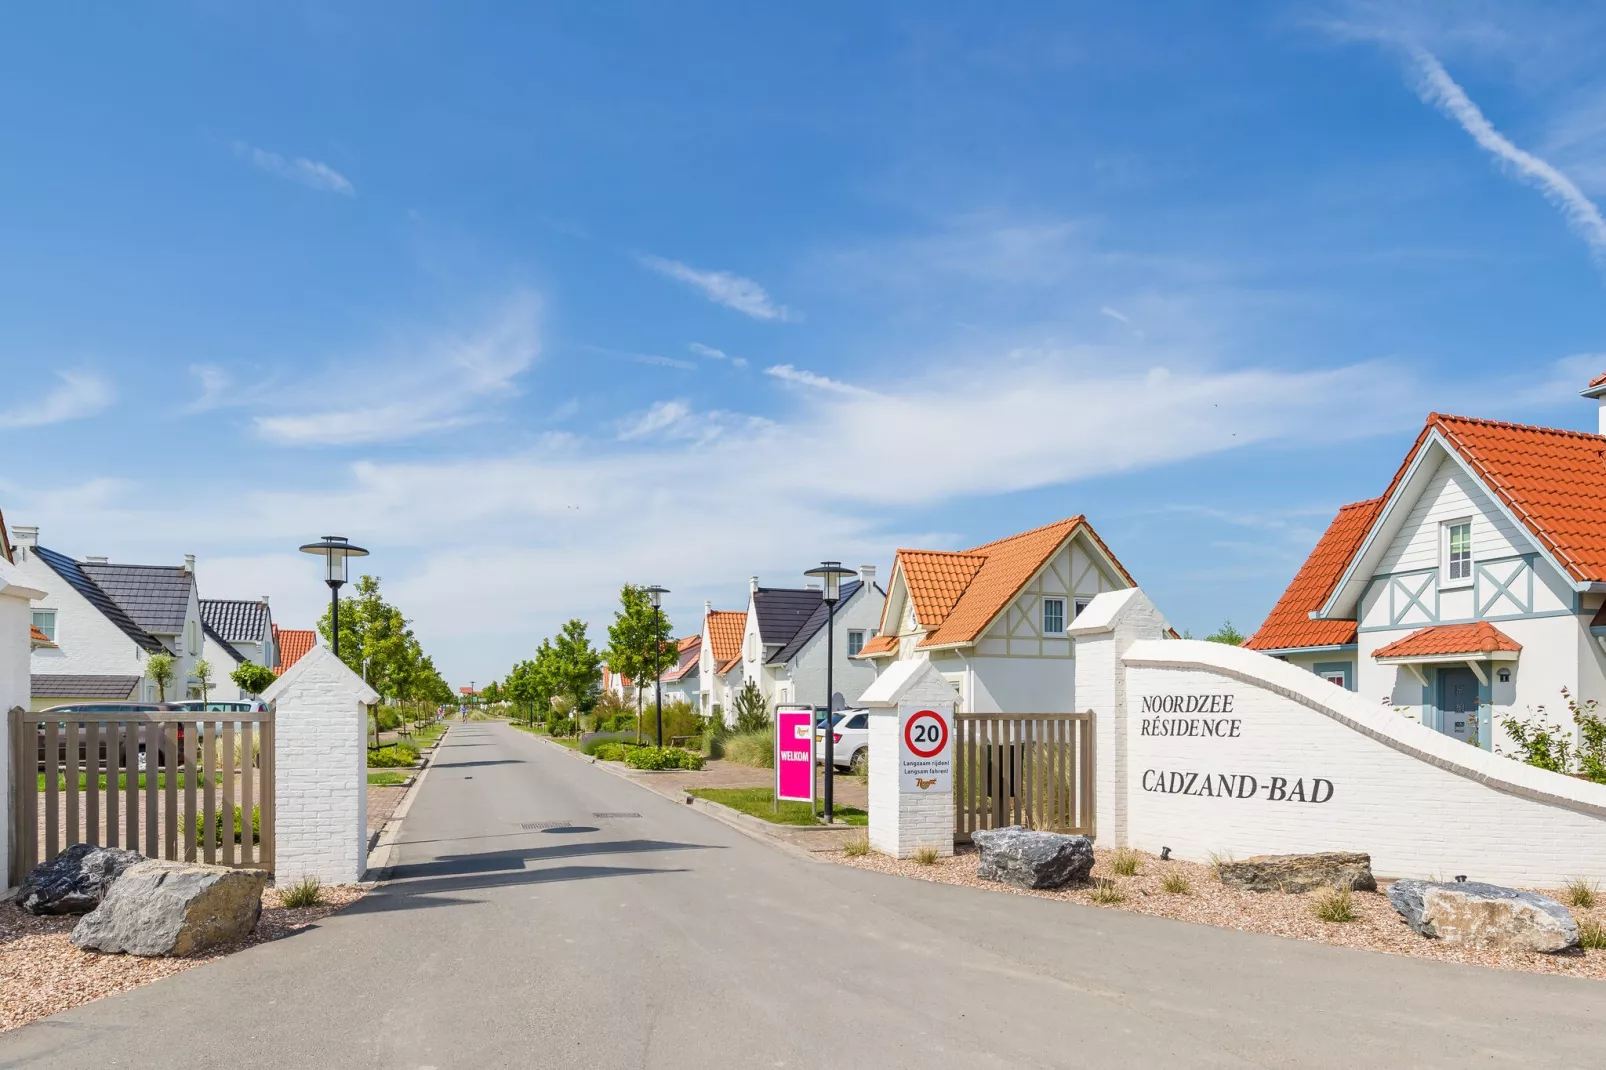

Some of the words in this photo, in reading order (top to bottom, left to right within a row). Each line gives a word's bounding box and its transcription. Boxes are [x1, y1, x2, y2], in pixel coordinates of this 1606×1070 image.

[1141, 694, 1234, 713] NOORDZEE
[914, 725, 939, 743] 20
[1140, 715, 1242, 738] RÉSIDENCE
[780, 750, 809, 762] WELKOM
[1142, 768, 1335, 804] CADZAND-BAD
